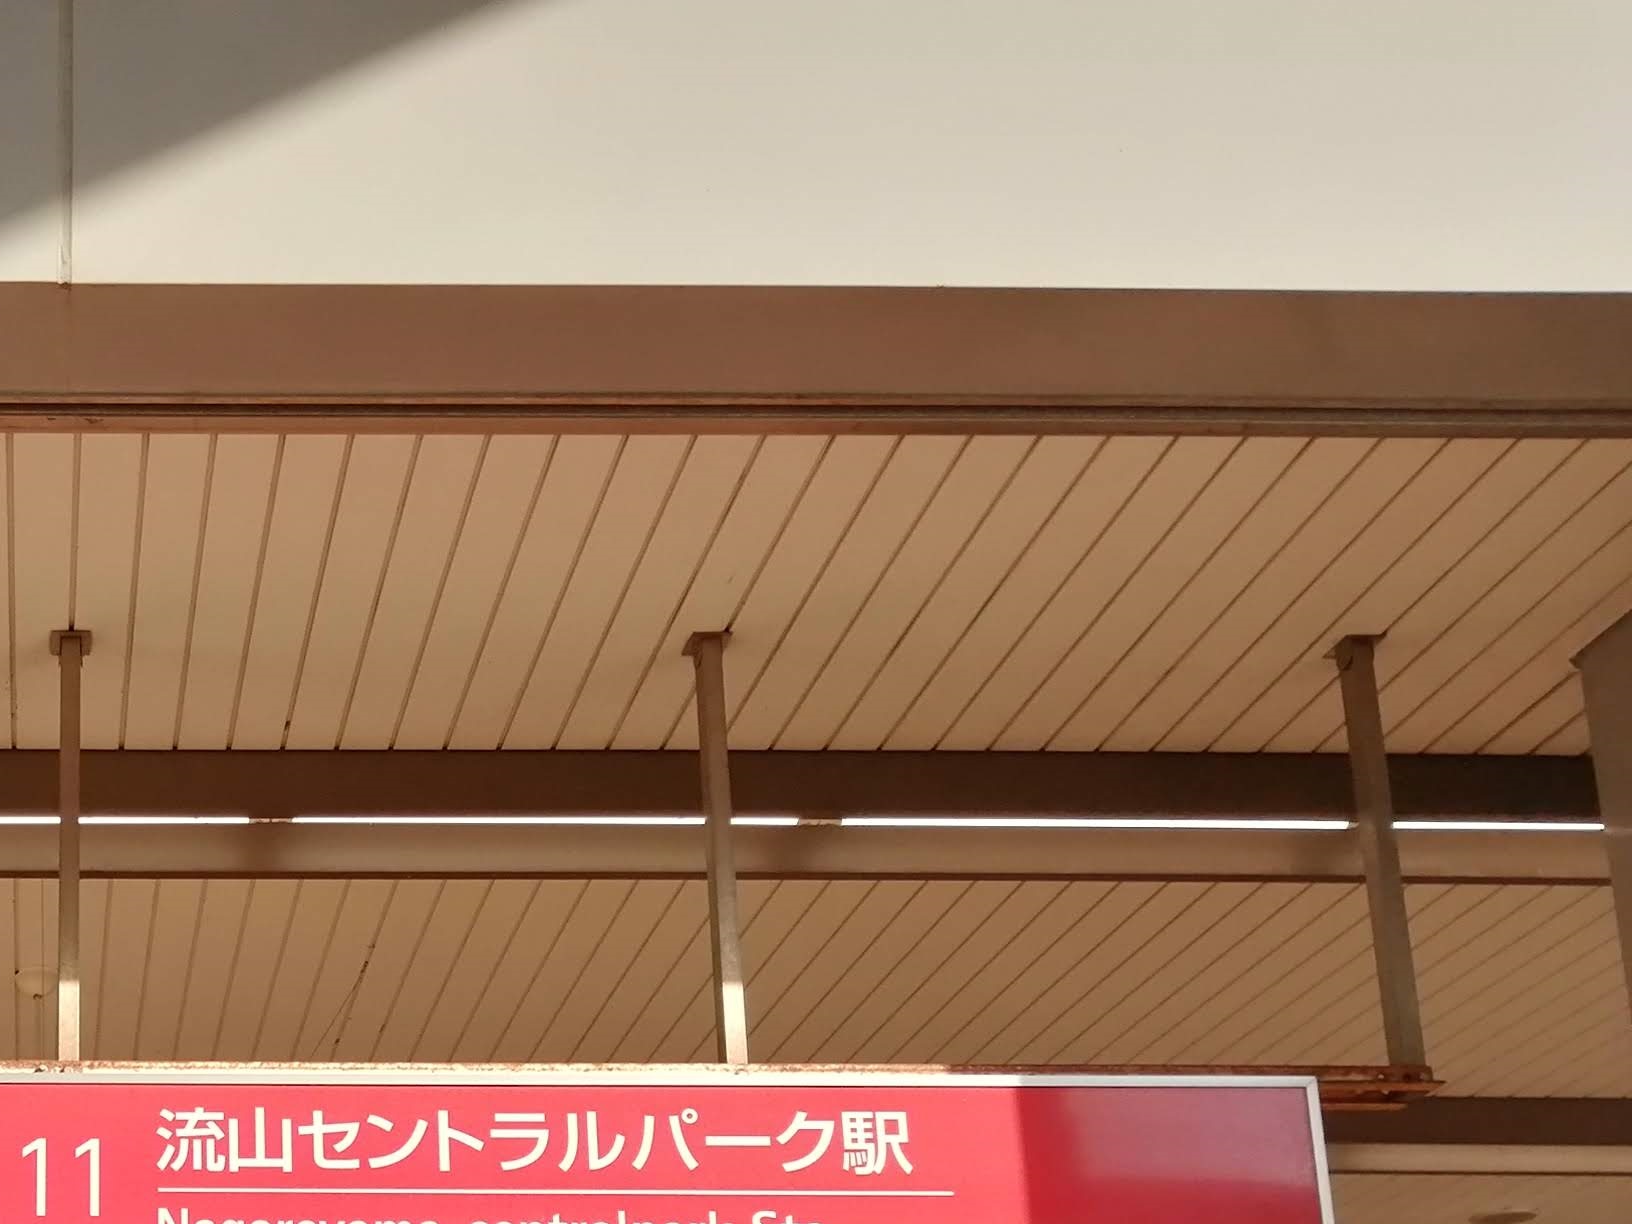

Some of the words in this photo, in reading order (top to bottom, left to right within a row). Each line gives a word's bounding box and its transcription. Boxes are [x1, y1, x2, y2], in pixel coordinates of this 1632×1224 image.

[20, 1136, 102, 1217] 11
[156, 1109, 913, 1175] 流山セントラルパーク駅
